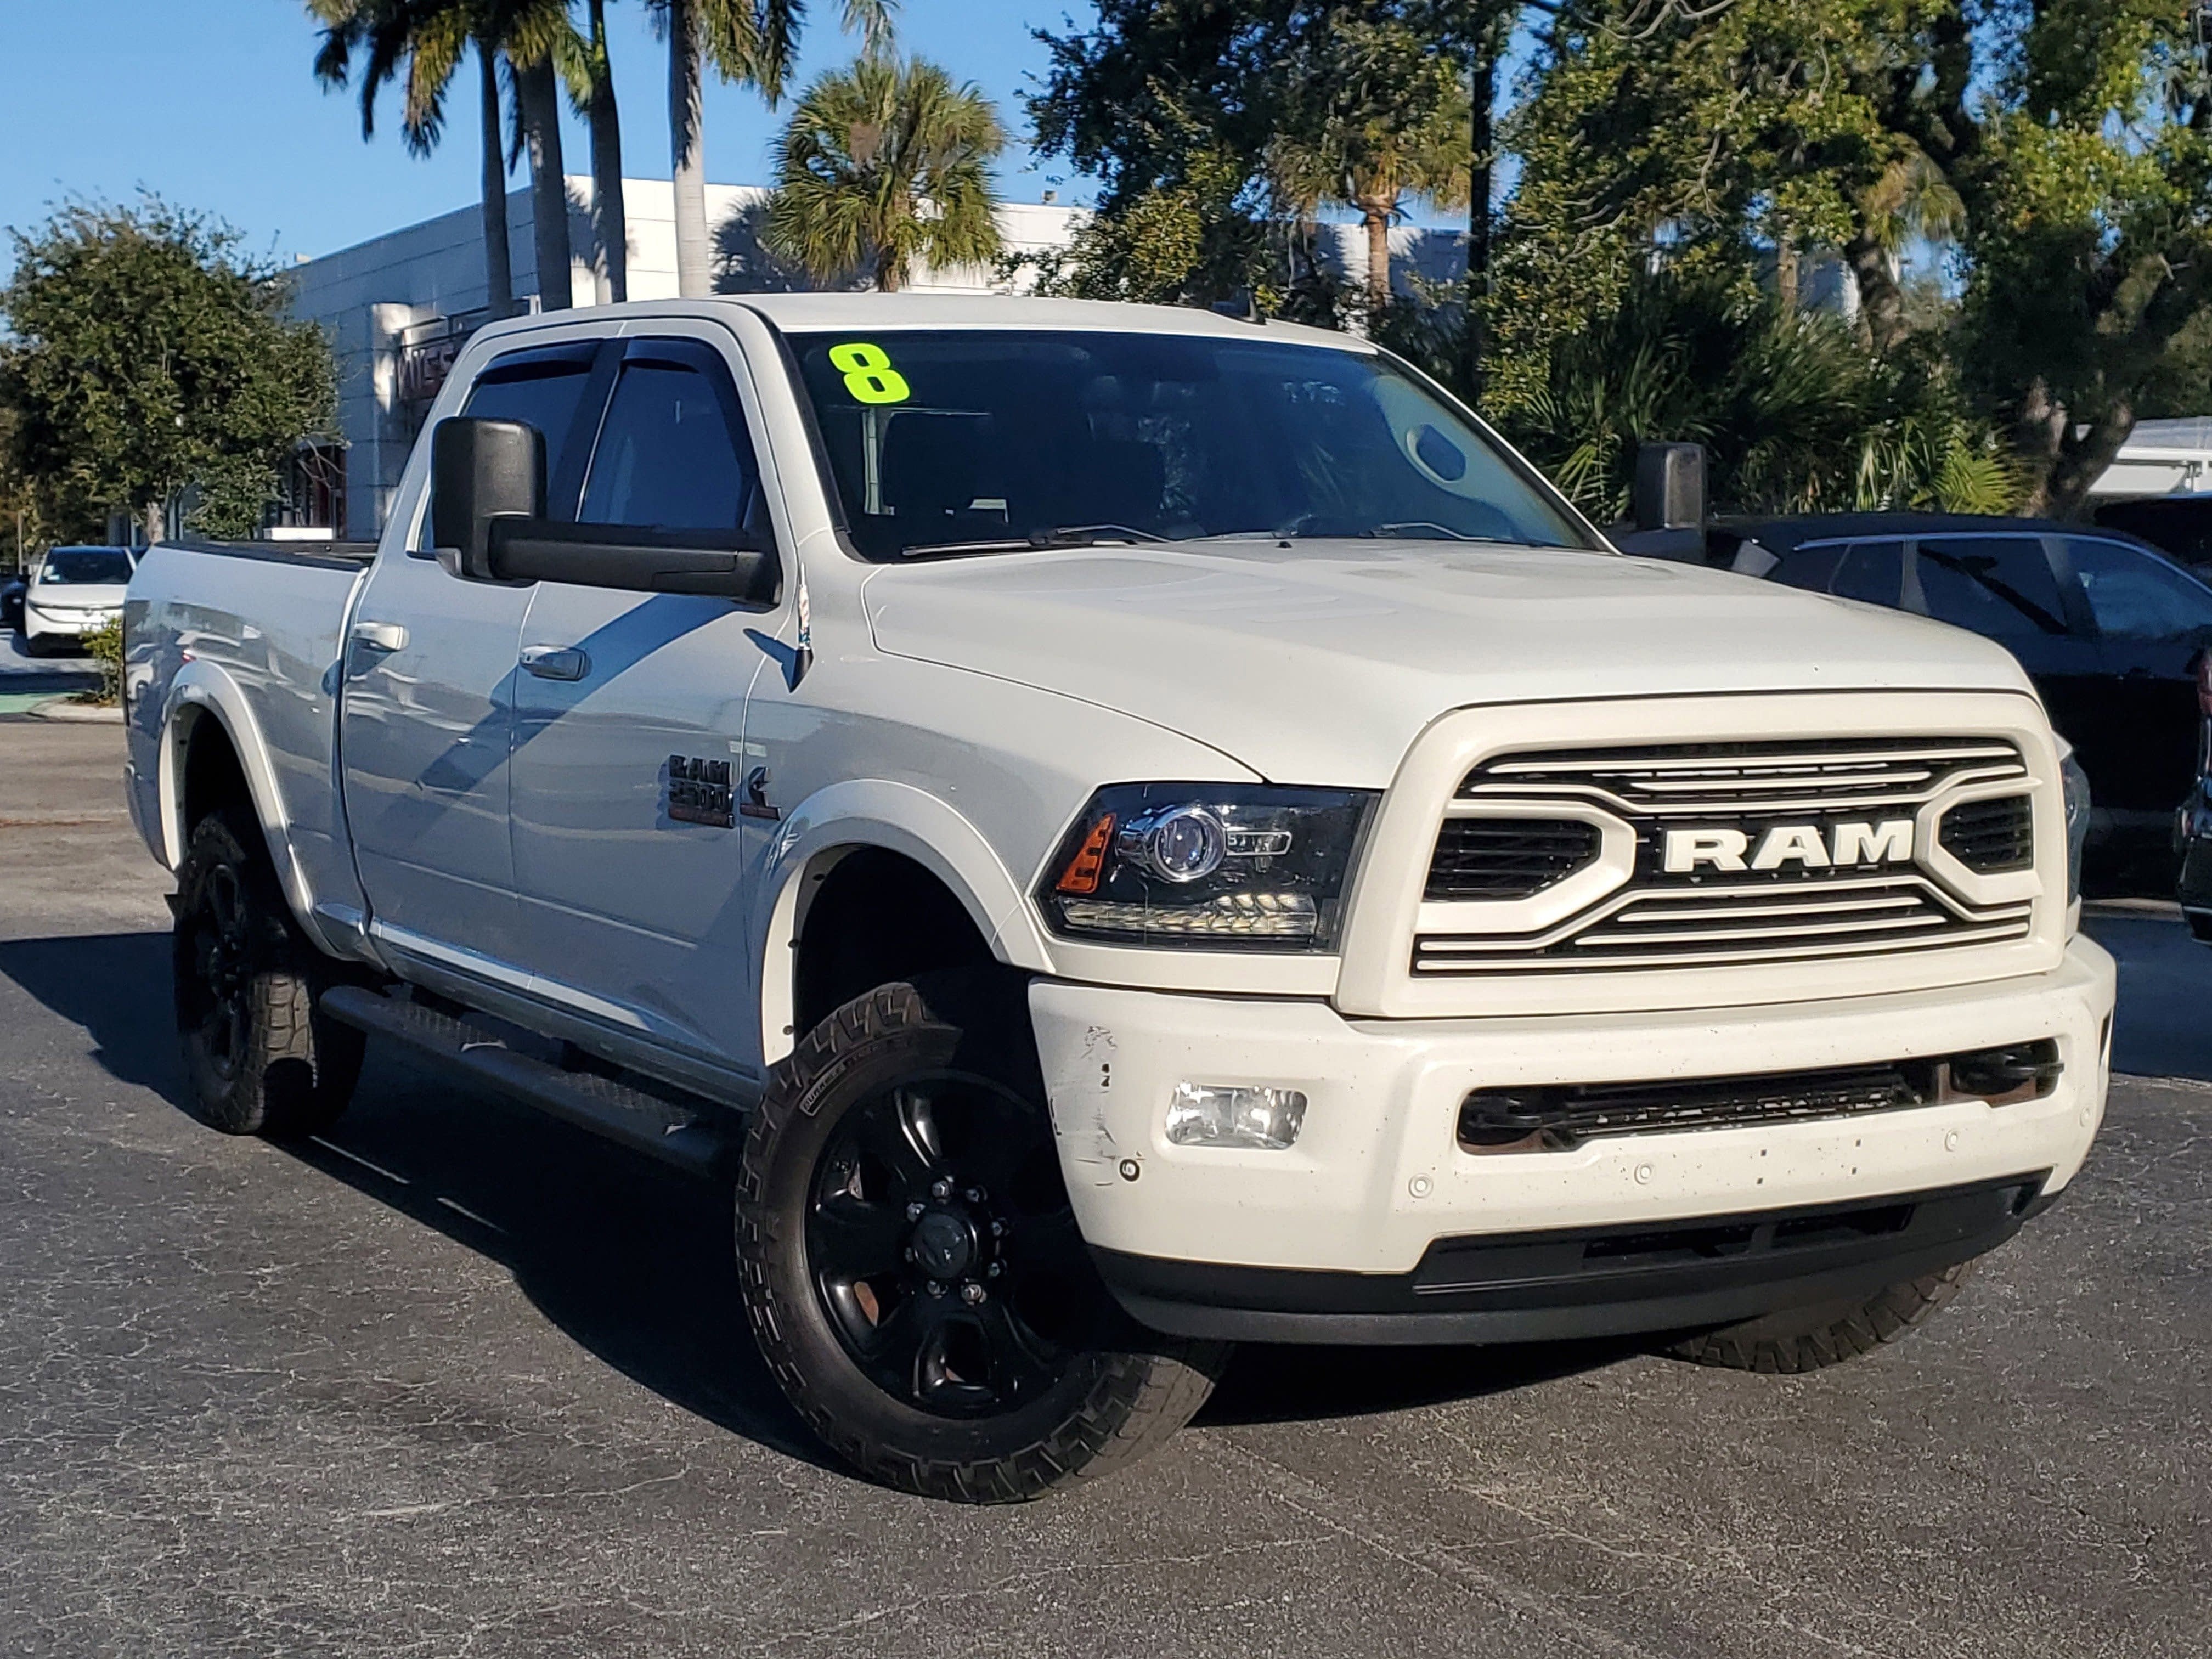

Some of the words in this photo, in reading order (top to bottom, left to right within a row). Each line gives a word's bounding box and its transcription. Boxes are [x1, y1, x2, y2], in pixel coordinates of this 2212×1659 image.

[829, 343, 910, 403] 8
[669, 754, 732, 786] RAM
[1664, 820, 1914, 872] RAM
